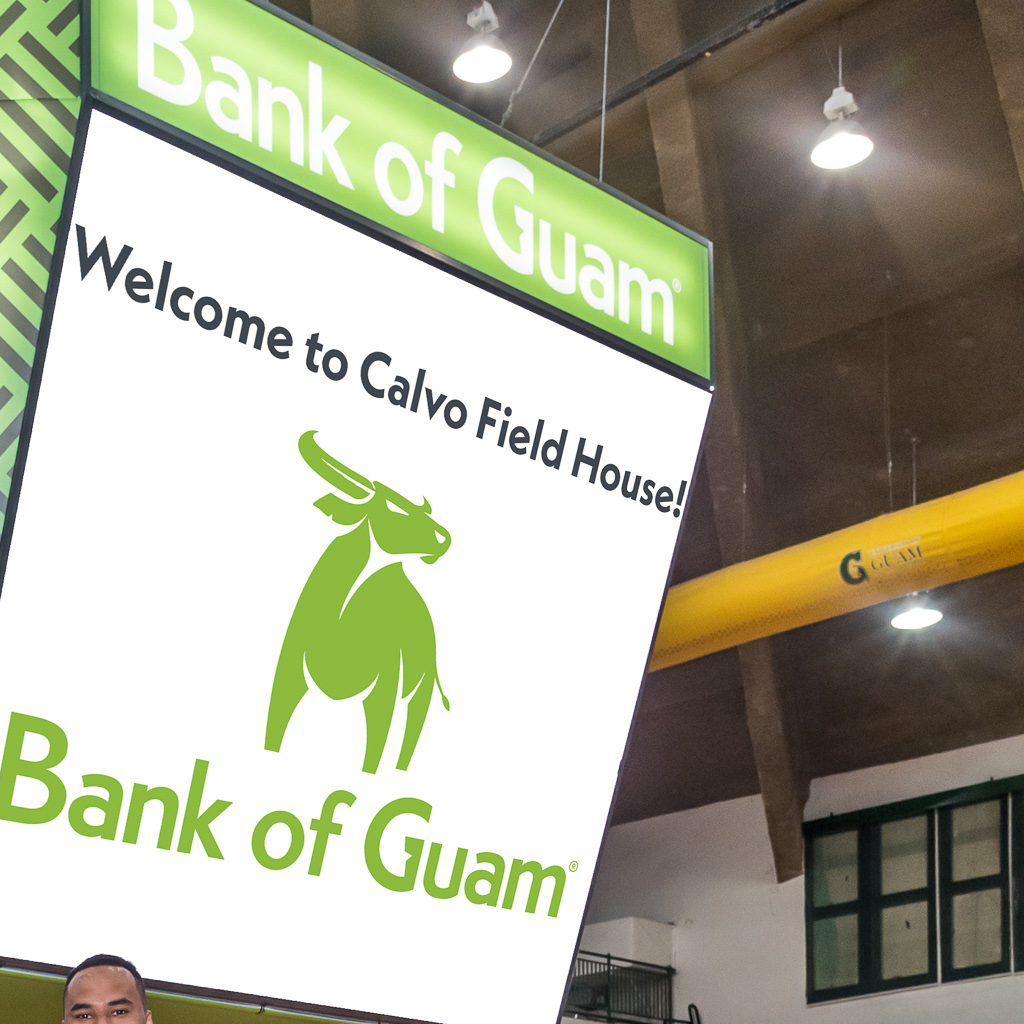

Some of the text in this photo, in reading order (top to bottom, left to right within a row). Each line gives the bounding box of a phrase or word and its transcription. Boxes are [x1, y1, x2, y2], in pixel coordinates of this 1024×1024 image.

[136, 0, 354, 191] Bank
[374, 130, 463, 234] of
[76, 223, 688, 518] Welcome to Calvo Field House!
[252, 789, 364, 877] of
